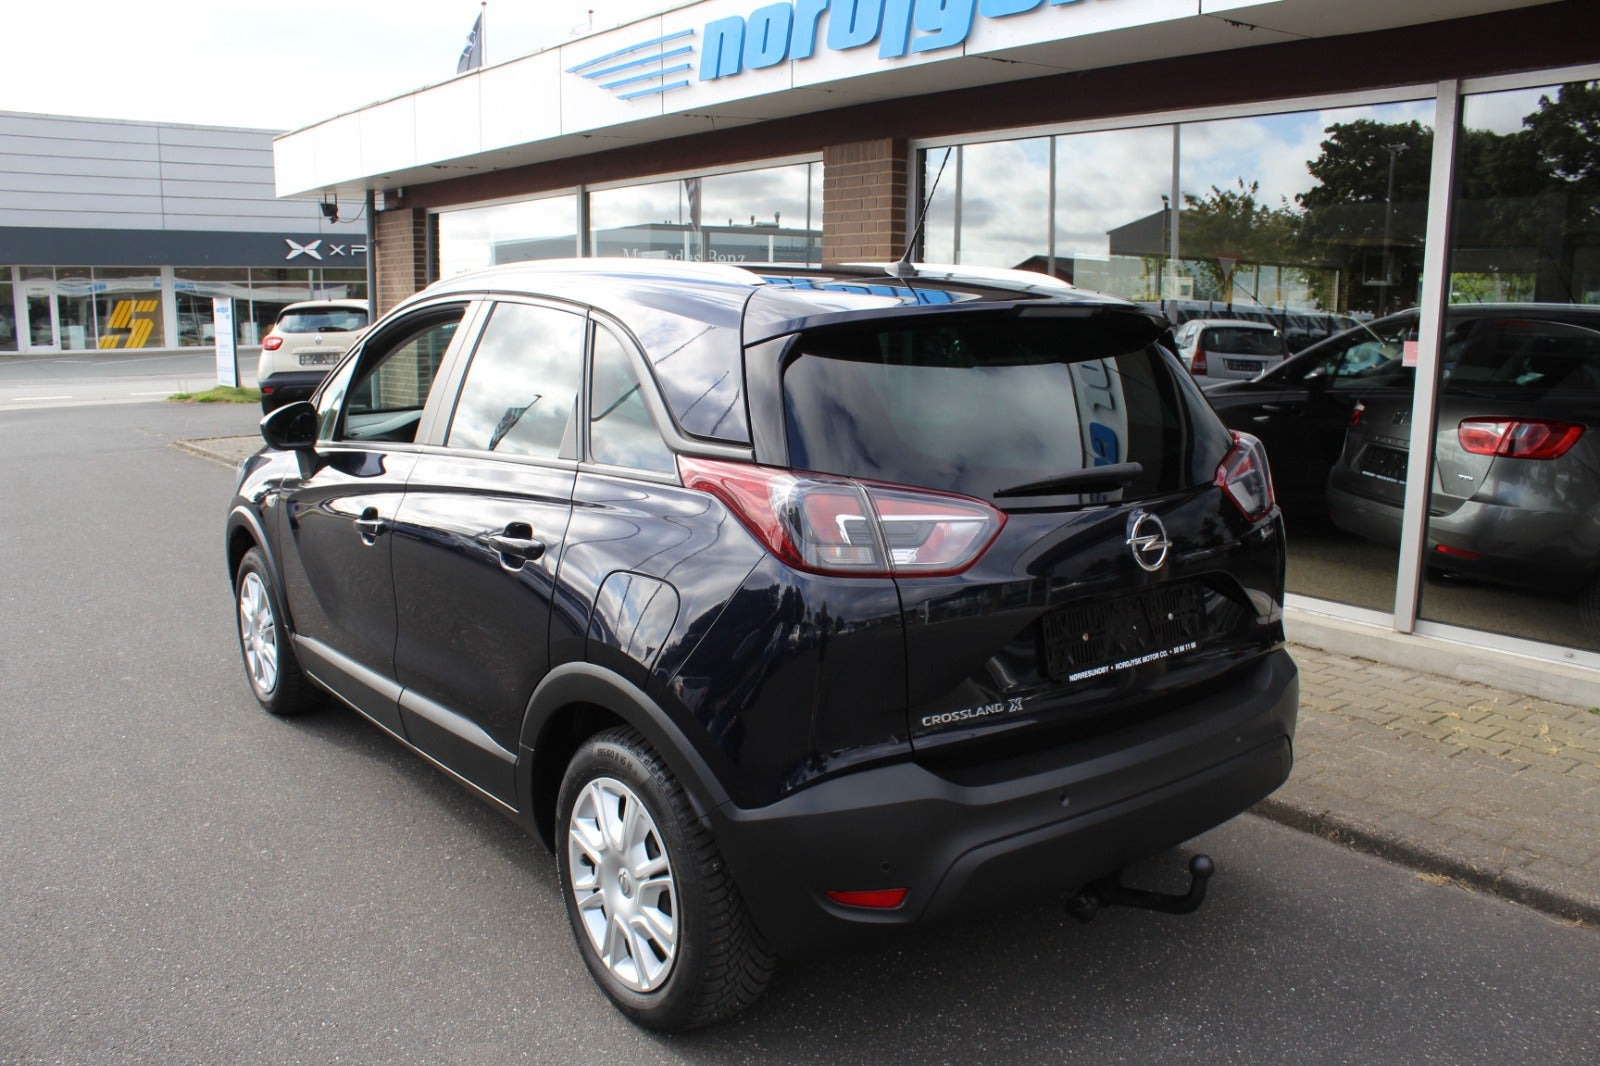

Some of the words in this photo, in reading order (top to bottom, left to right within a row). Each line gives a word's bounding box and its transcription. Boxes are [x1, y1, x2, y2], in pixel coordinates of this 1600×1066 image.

[1142, 652, 1159, 663] MOTOR
[922, 703, 1004, 727] CROSSLAND
[1008, 697, 1024, 713] X
